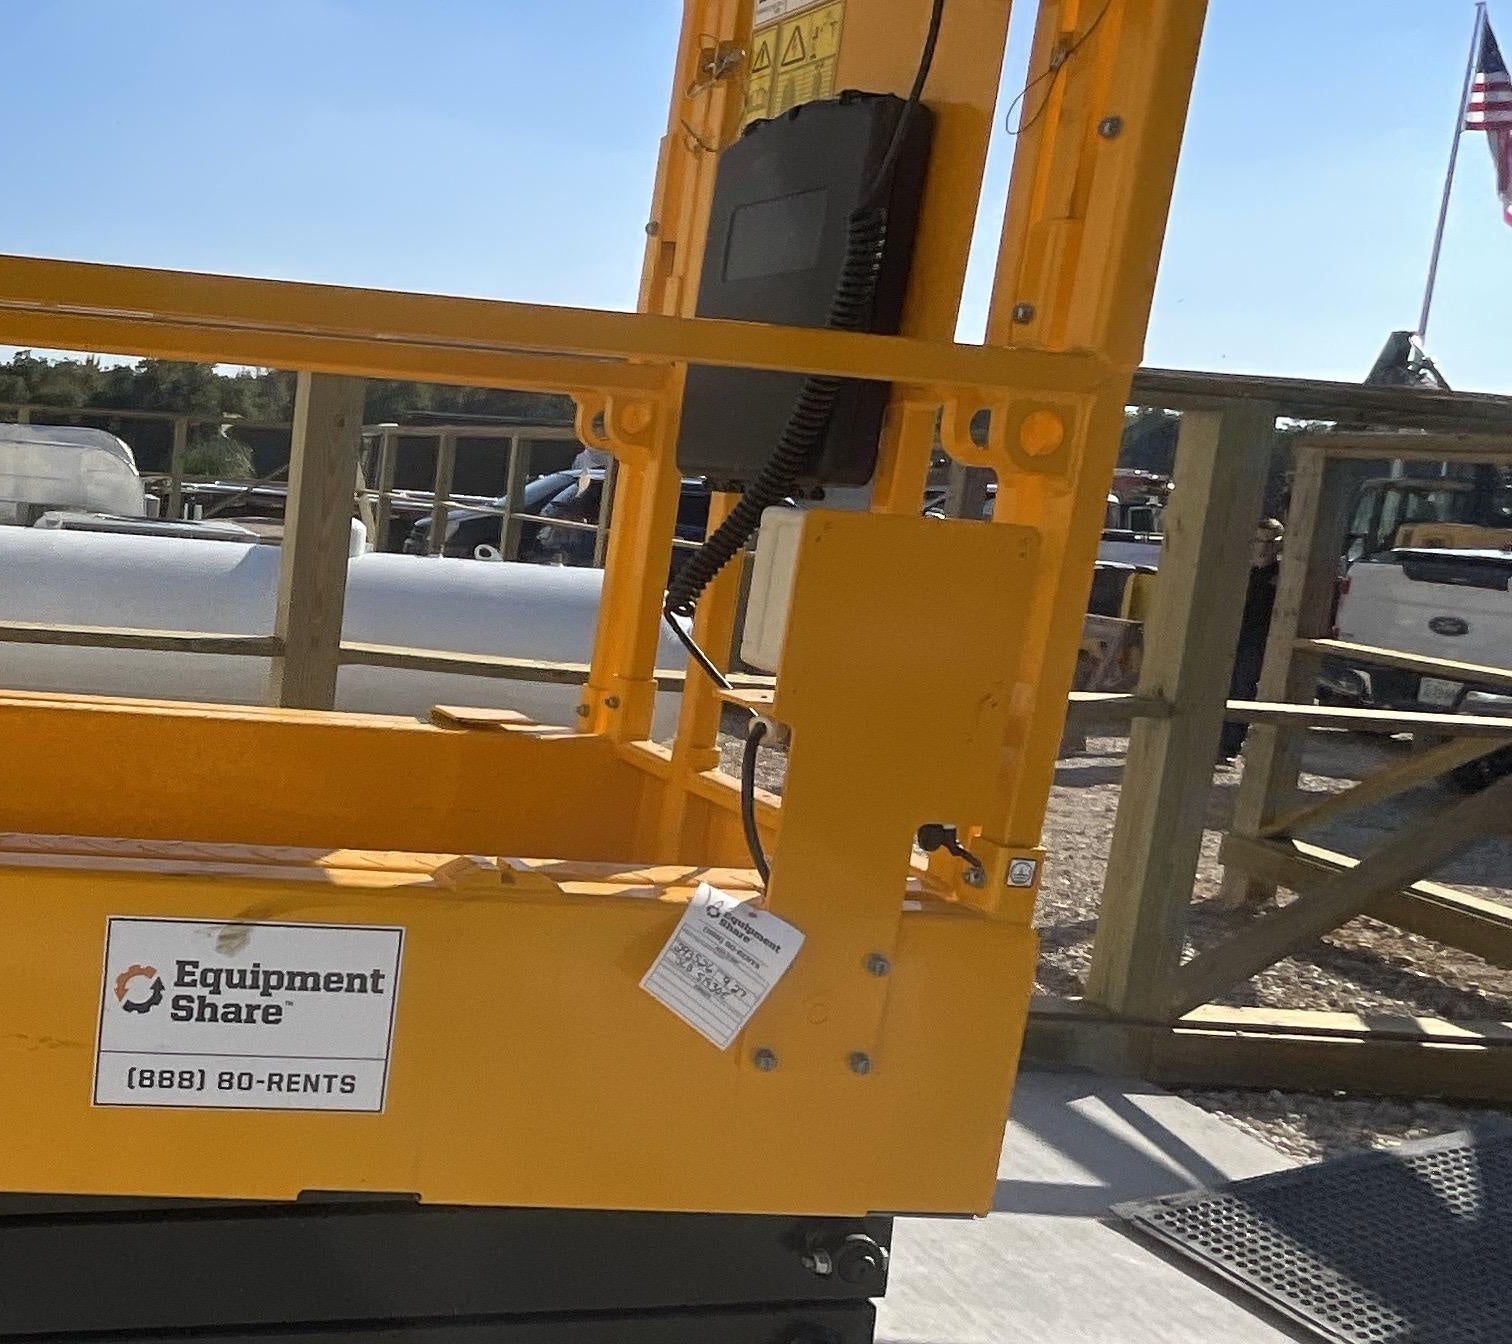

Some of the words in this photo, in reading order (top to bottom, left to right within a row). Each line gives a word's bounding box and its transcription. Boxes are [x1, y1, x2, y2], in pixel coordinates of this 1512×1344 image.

[721, 910, 782, 954] Equipment
[173, 959, 386, 997] Equipment
[127, 1066, 206, 1092] (888)
[217, 1071, 357, 1094] 80-RENTS
